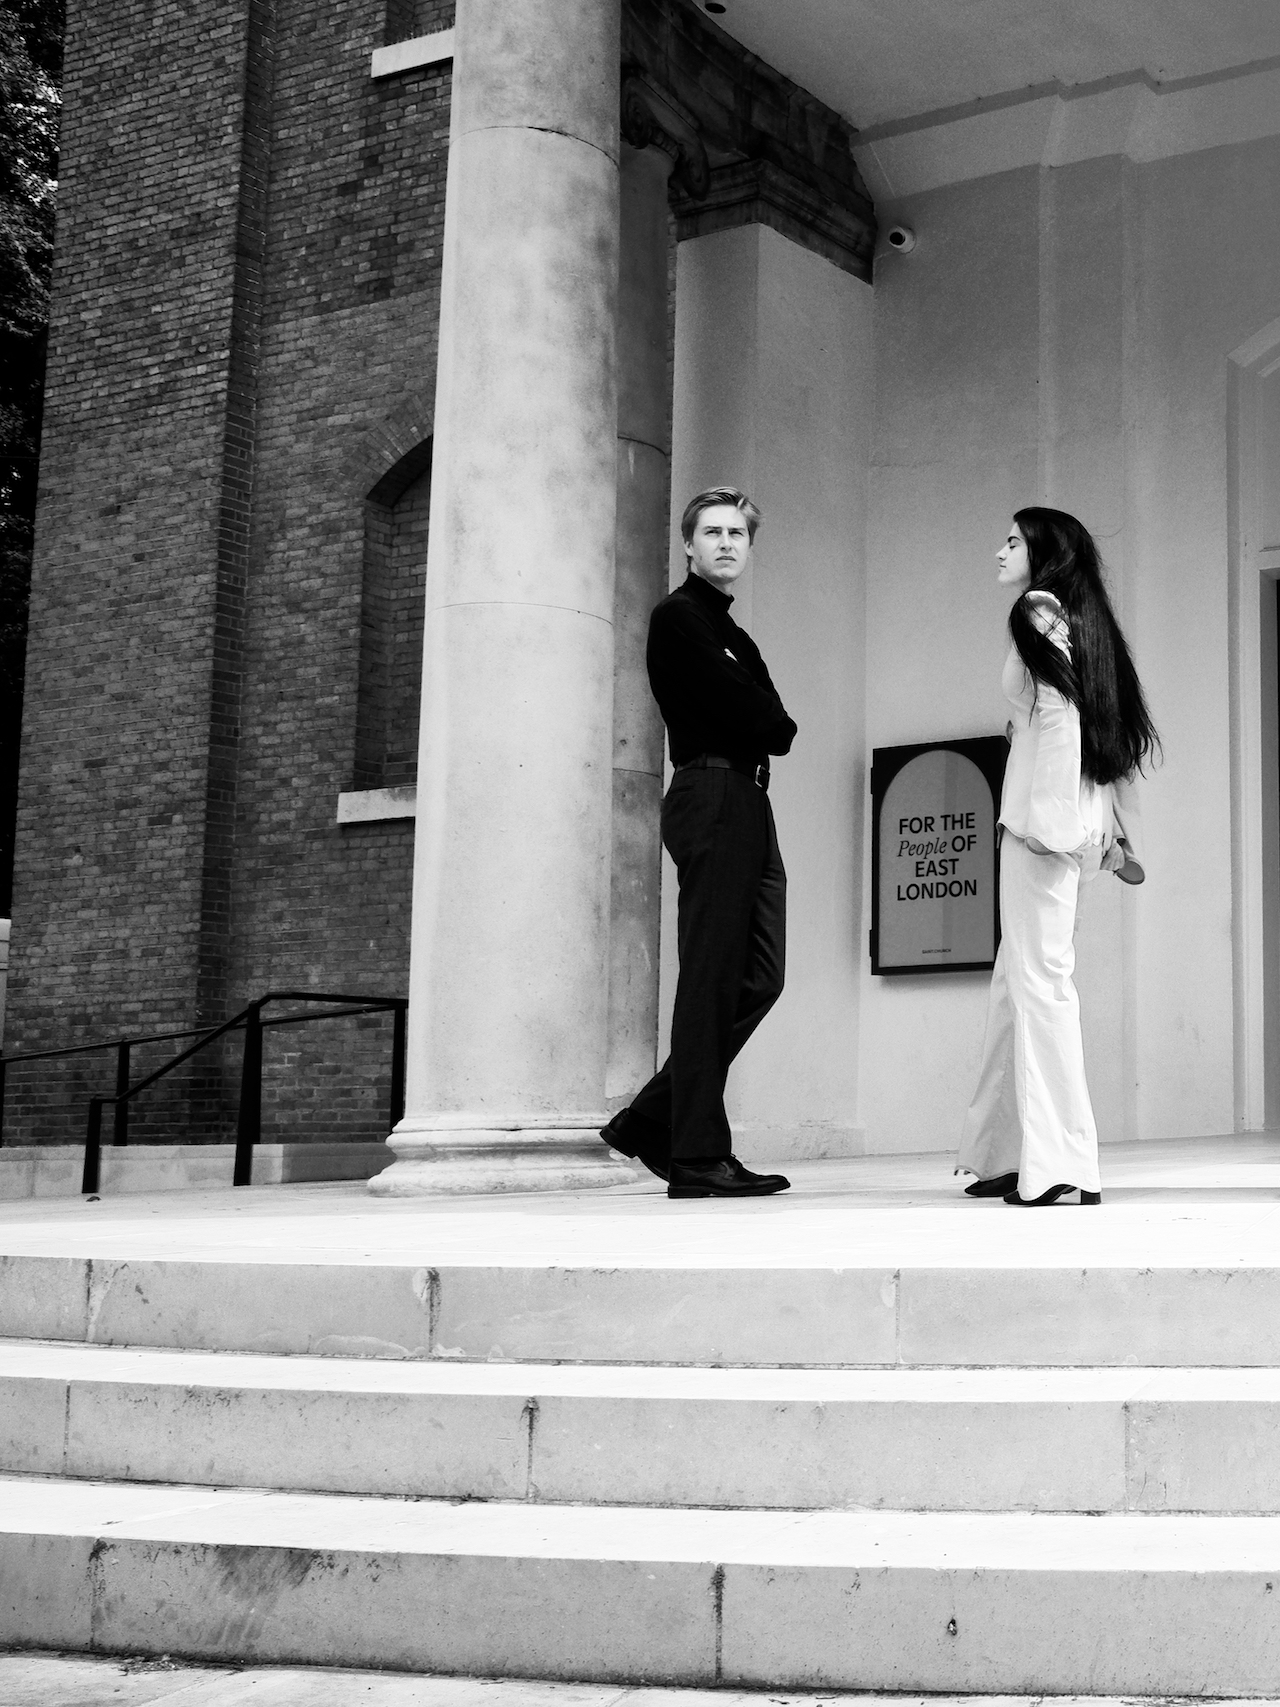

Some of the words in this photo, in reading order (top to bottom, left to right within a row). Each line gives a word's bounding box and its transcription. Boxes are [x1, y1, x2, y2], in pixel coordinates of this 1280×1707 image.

[899, 816, 935, 835] FOR
[940, 812, 976, 831] THE
[897, 837, 948, 859] People
[951, 834, 977, 852] OF
[915, 858, 960, 878] EAST
[897, 879, 977, 901] LONDON
